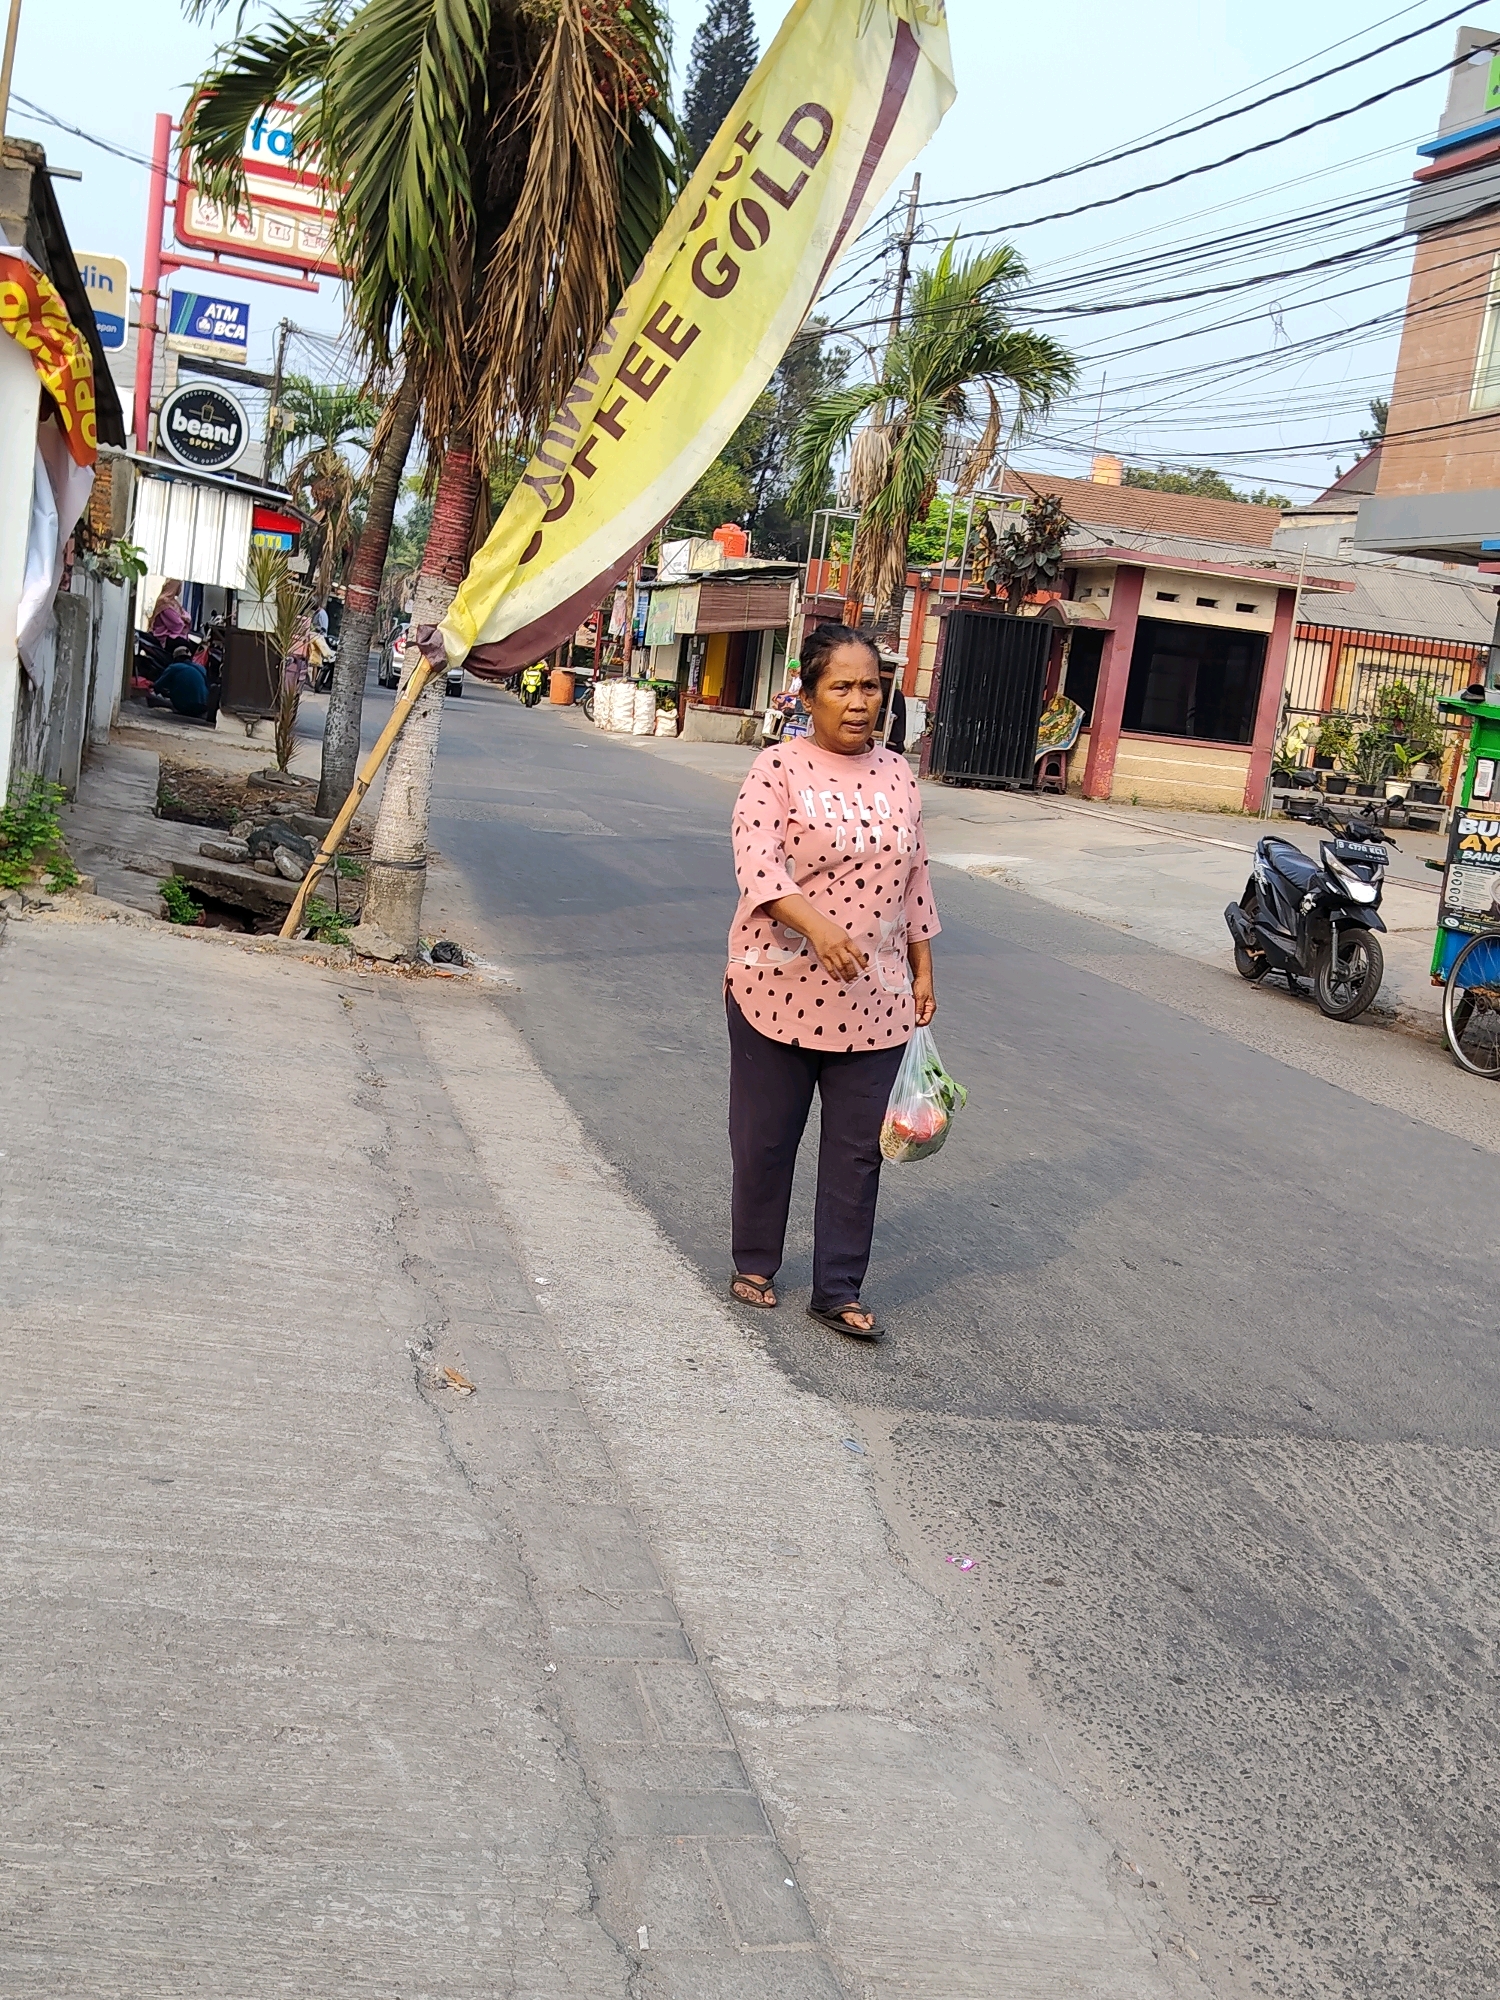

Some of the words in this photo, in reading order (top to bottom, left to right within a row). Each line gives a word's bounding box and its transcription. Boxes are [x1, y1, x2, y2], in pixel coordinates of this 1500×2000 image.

[691, 102, 834, 299] GOLD
[204, 302, 239, 323] ATM
[212, 320, 246, 340] BCA
[171, 407, 238, 446] bean!
[188, 437, 216, 451] SPOT
[251, 533, 282, 549] OTI
[799, 789, 892, 820] HELLO
[1457, 817, 1500, 837] BU
[835, 825, 883, 854] CAT
[1459, 834, 1500, 853] AY
